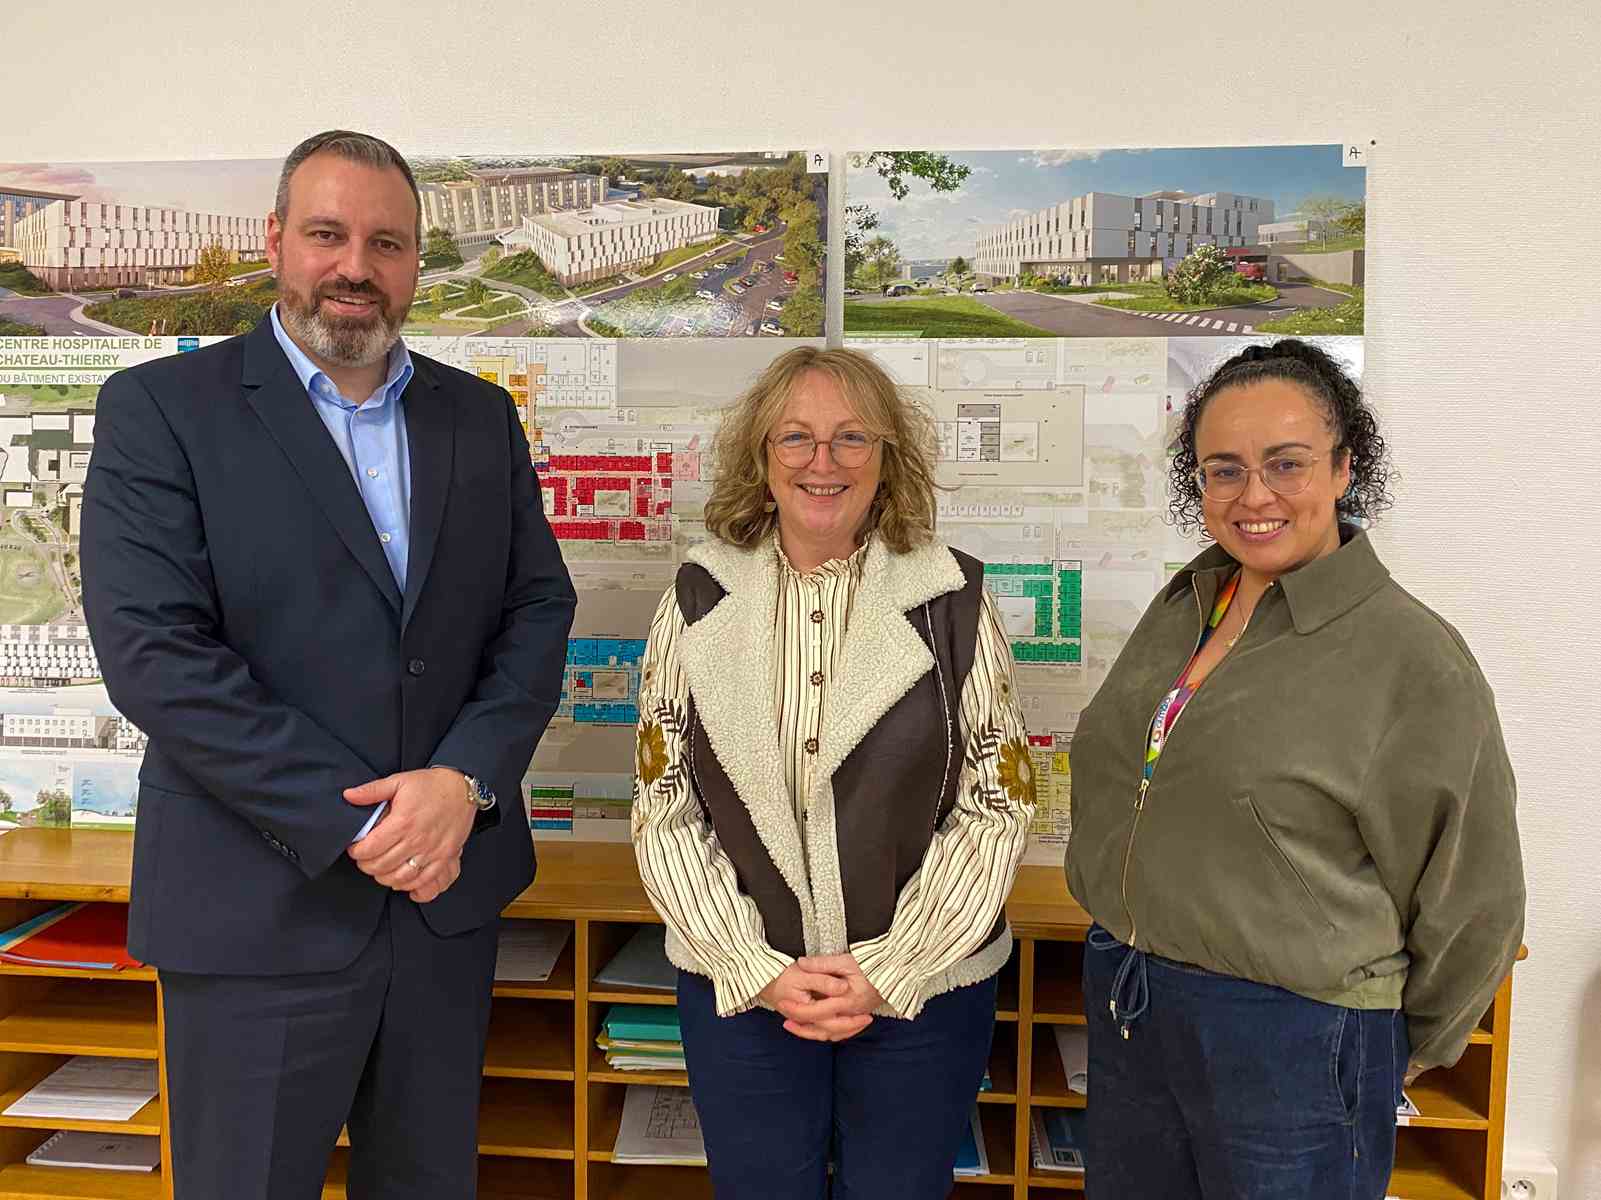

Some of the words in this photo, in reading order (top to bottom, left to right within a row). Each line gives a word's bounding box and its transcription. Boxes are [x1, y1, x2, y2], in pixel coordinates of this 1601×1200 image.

[53, 338, 140, 349] HOSPITALIER
[144, 338, 162, 349] DE
[13, 372, 65, 383] BÂTIMENT
